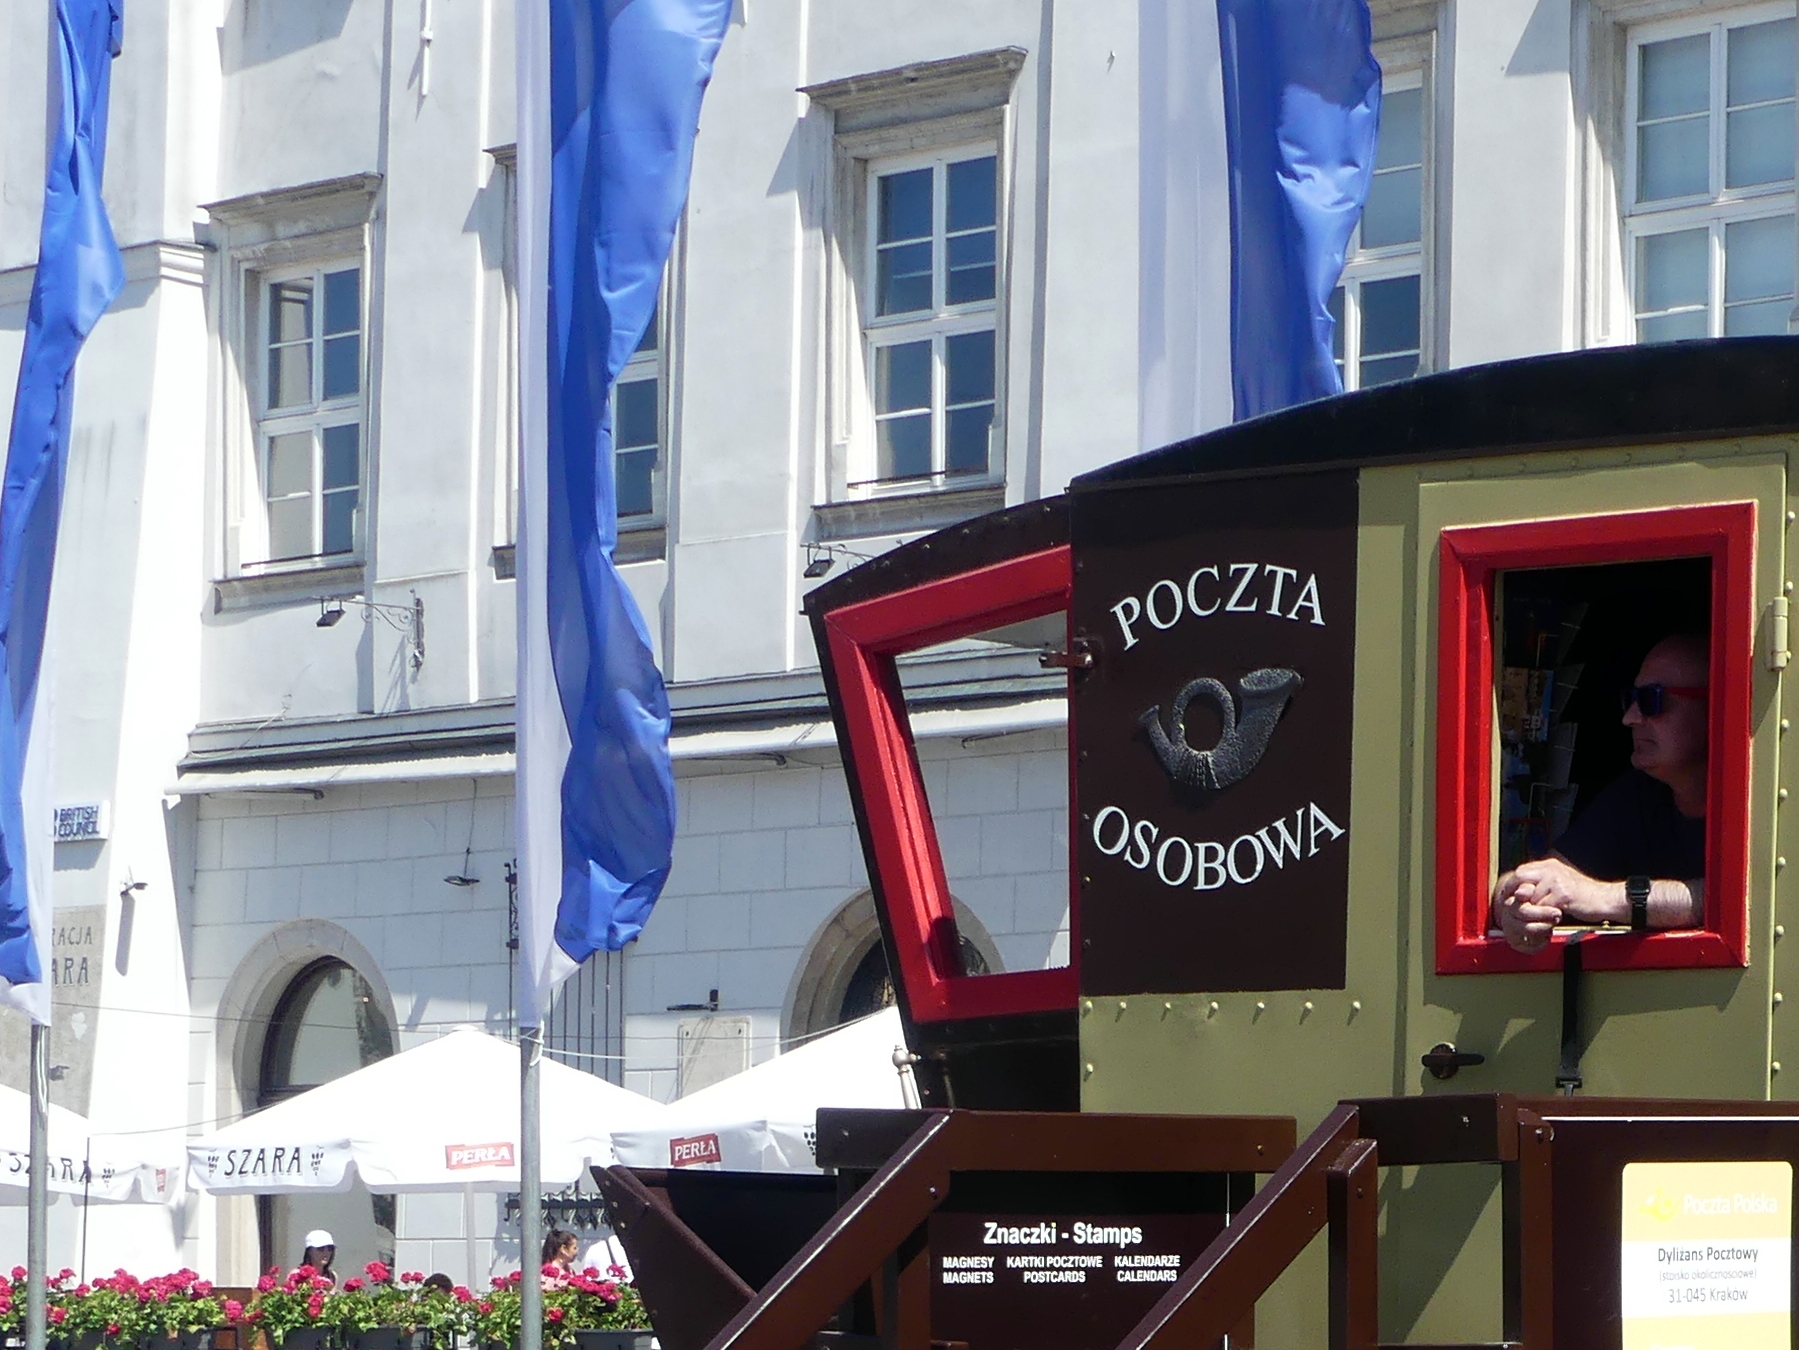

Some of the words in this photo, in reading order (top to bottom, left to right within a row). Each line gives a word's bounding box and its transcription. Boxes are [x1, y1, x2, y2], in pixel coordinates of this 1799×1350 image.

[1110, 563, 1326, 651] POCZTA
[58, 821, 100, 837] COUNCIL
[1093, 801, 1346, 890] OSOBOWA
[451, 1145, 512, 1166] PERŁA
[674, 1139, 717, 1161] PERŁA
[224, 1147, 301, 1176] SZARA
[983, 1222, 1056, 1244] Znaczki
[1073, 1222, 1143, 1248] Stamps
[943, 1257, 995, 1269] MAGNESY
[1007, 1256, 1045, 1268] KARTKI
[1046, 1256, 1103, 1268] POCZTOWE
[1114, 1255, 1181, 1267] KALENDARZE
[1658, 1247, 1704, 1265] Dyliżans
[1707, 1246, 1759, 1263] Pocztowy
[943, 1272, 994, 1283] MAGNETS
[1023, 1271, 1086, 1283] POSTCARDS
[1117, 1270, 1177, 1282] CALENDARS
[1668, 1288, 1706, 1304] 31-045
[1710, 1287, 1749, 1302] Kraków
